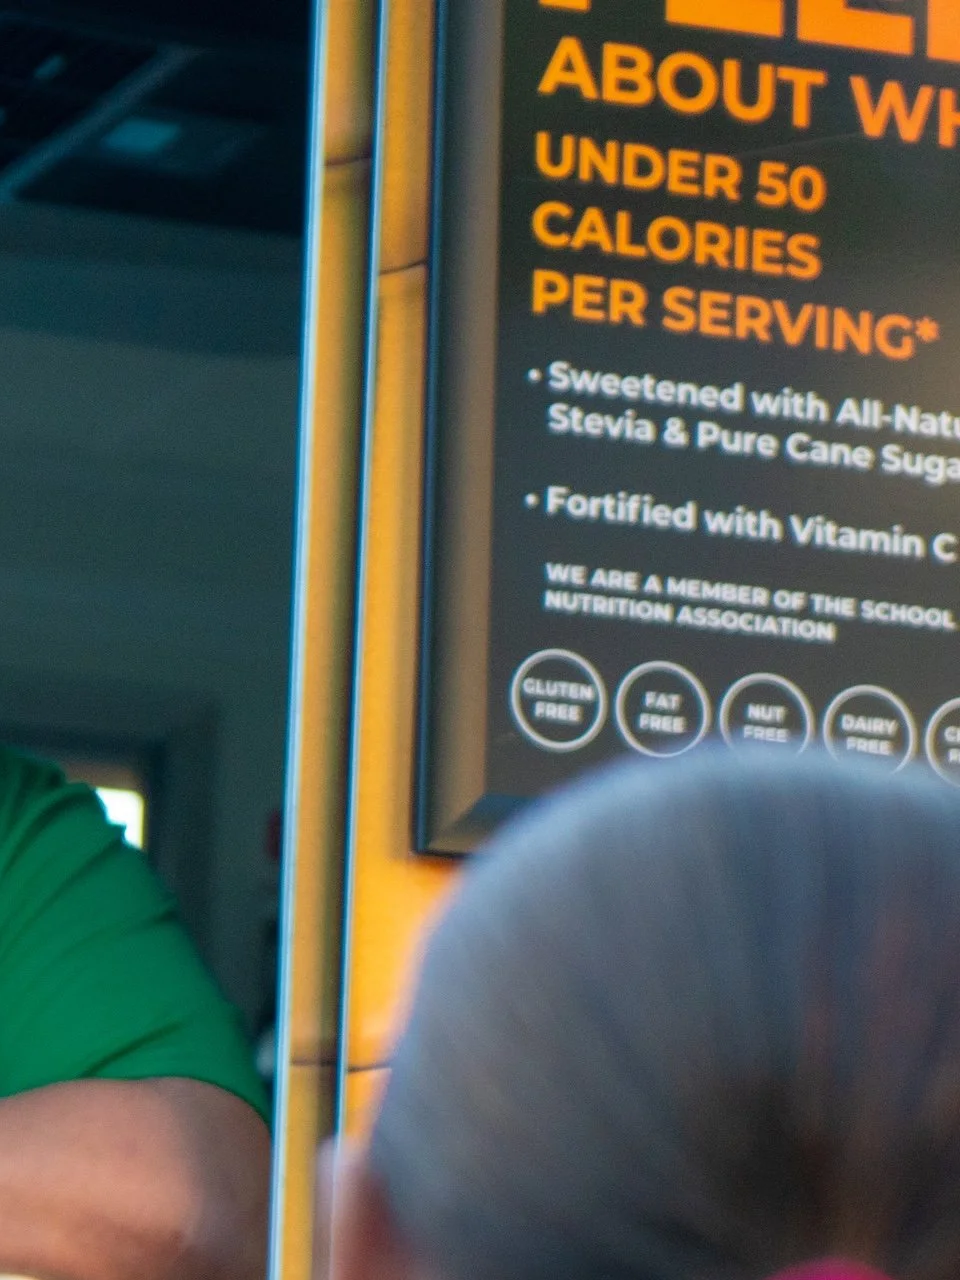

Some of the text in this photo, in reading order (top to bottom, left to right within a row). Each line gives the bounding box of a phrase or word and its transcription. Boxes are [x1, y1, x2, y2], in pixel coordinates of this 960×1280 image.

[538, 36, 826, 128] ABOUT
[535, 132, 826, 210] UNDER 50
[532, 202, 822, 279] CALORIES
[532, 269, 648, 326] PER
[547, 361, 744, 412] Sweetened
[752, 387, 828, 423] with
[547, 403, 960, 485] Stevia & Pure Cane Suga
[545, 485, 958, 563] Fortified with Vitamin C
[545, 562, 956, 630] WE ARE A MEMBER OF THE SCHOOL
[545, 590, 836, 643] NUTRITION ASSOCIATION
[522, 677, 595, 701] GLUTEN
[533, 701, 584, 724] FREE
[644, 690, 682, 711] FAT
[747, 702, 786, 723] NUT
[638, 712, 687, 734] FREE
[743, 724, 789, 743] FREE
[841, 713, 898, 736] DAIRY
[845, 735, 892, 756] FREE
